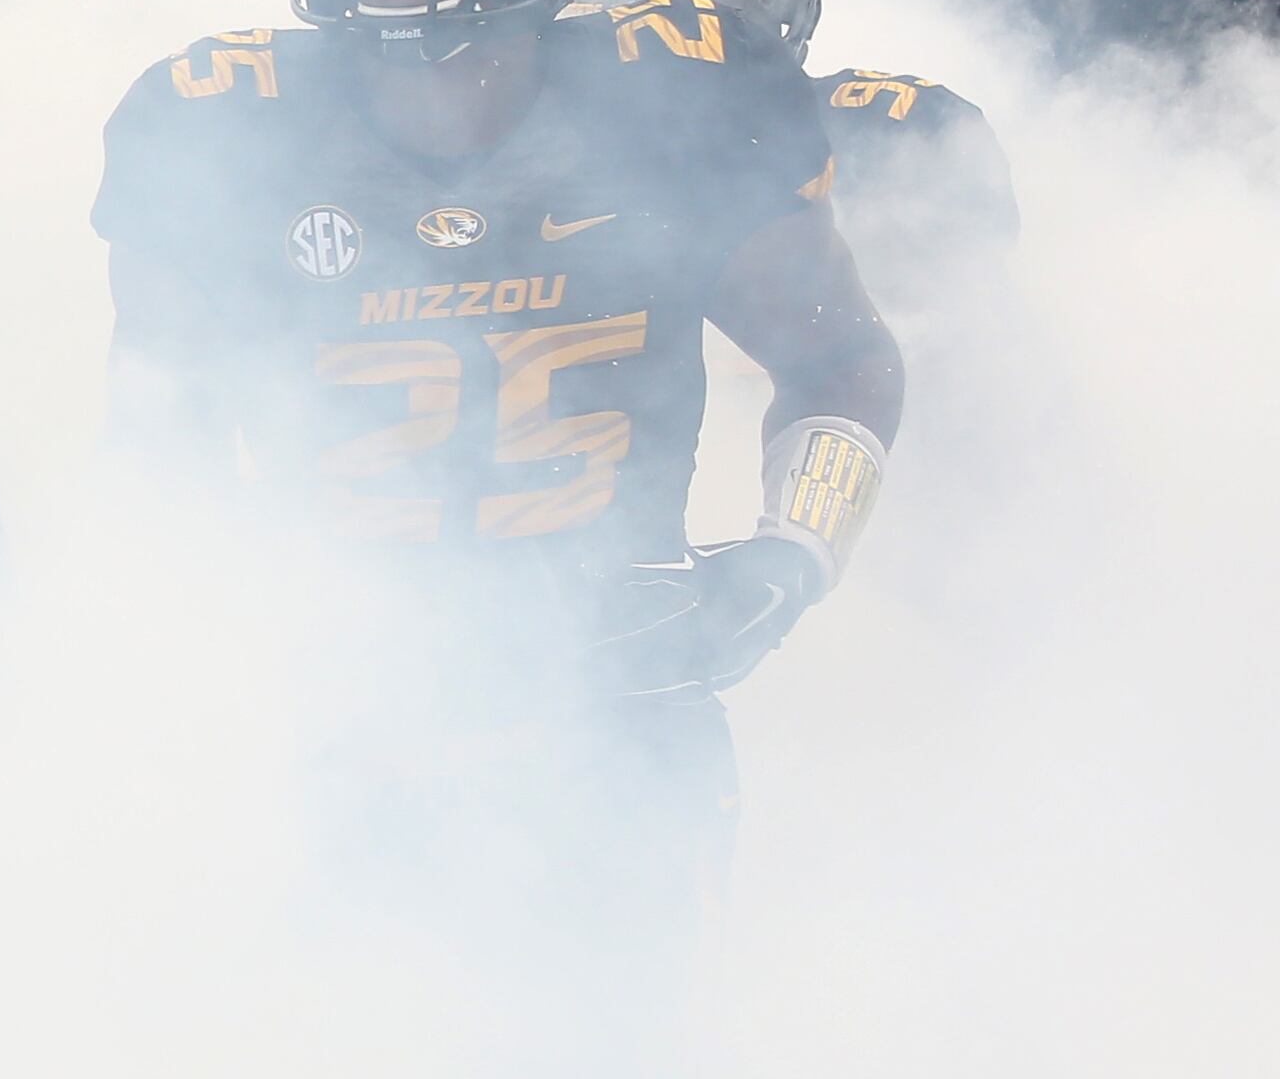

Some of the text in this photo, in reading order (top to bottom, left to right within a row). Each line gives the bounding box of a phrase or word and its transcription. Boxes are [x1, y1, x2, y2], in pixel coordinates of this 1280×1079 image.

[381, 28, 424, 40] Riddell
[291, 210, 358, 277] SEC
[359, 273, 568, 326] MIZZOU
[314, 310, 649, 542] 25
